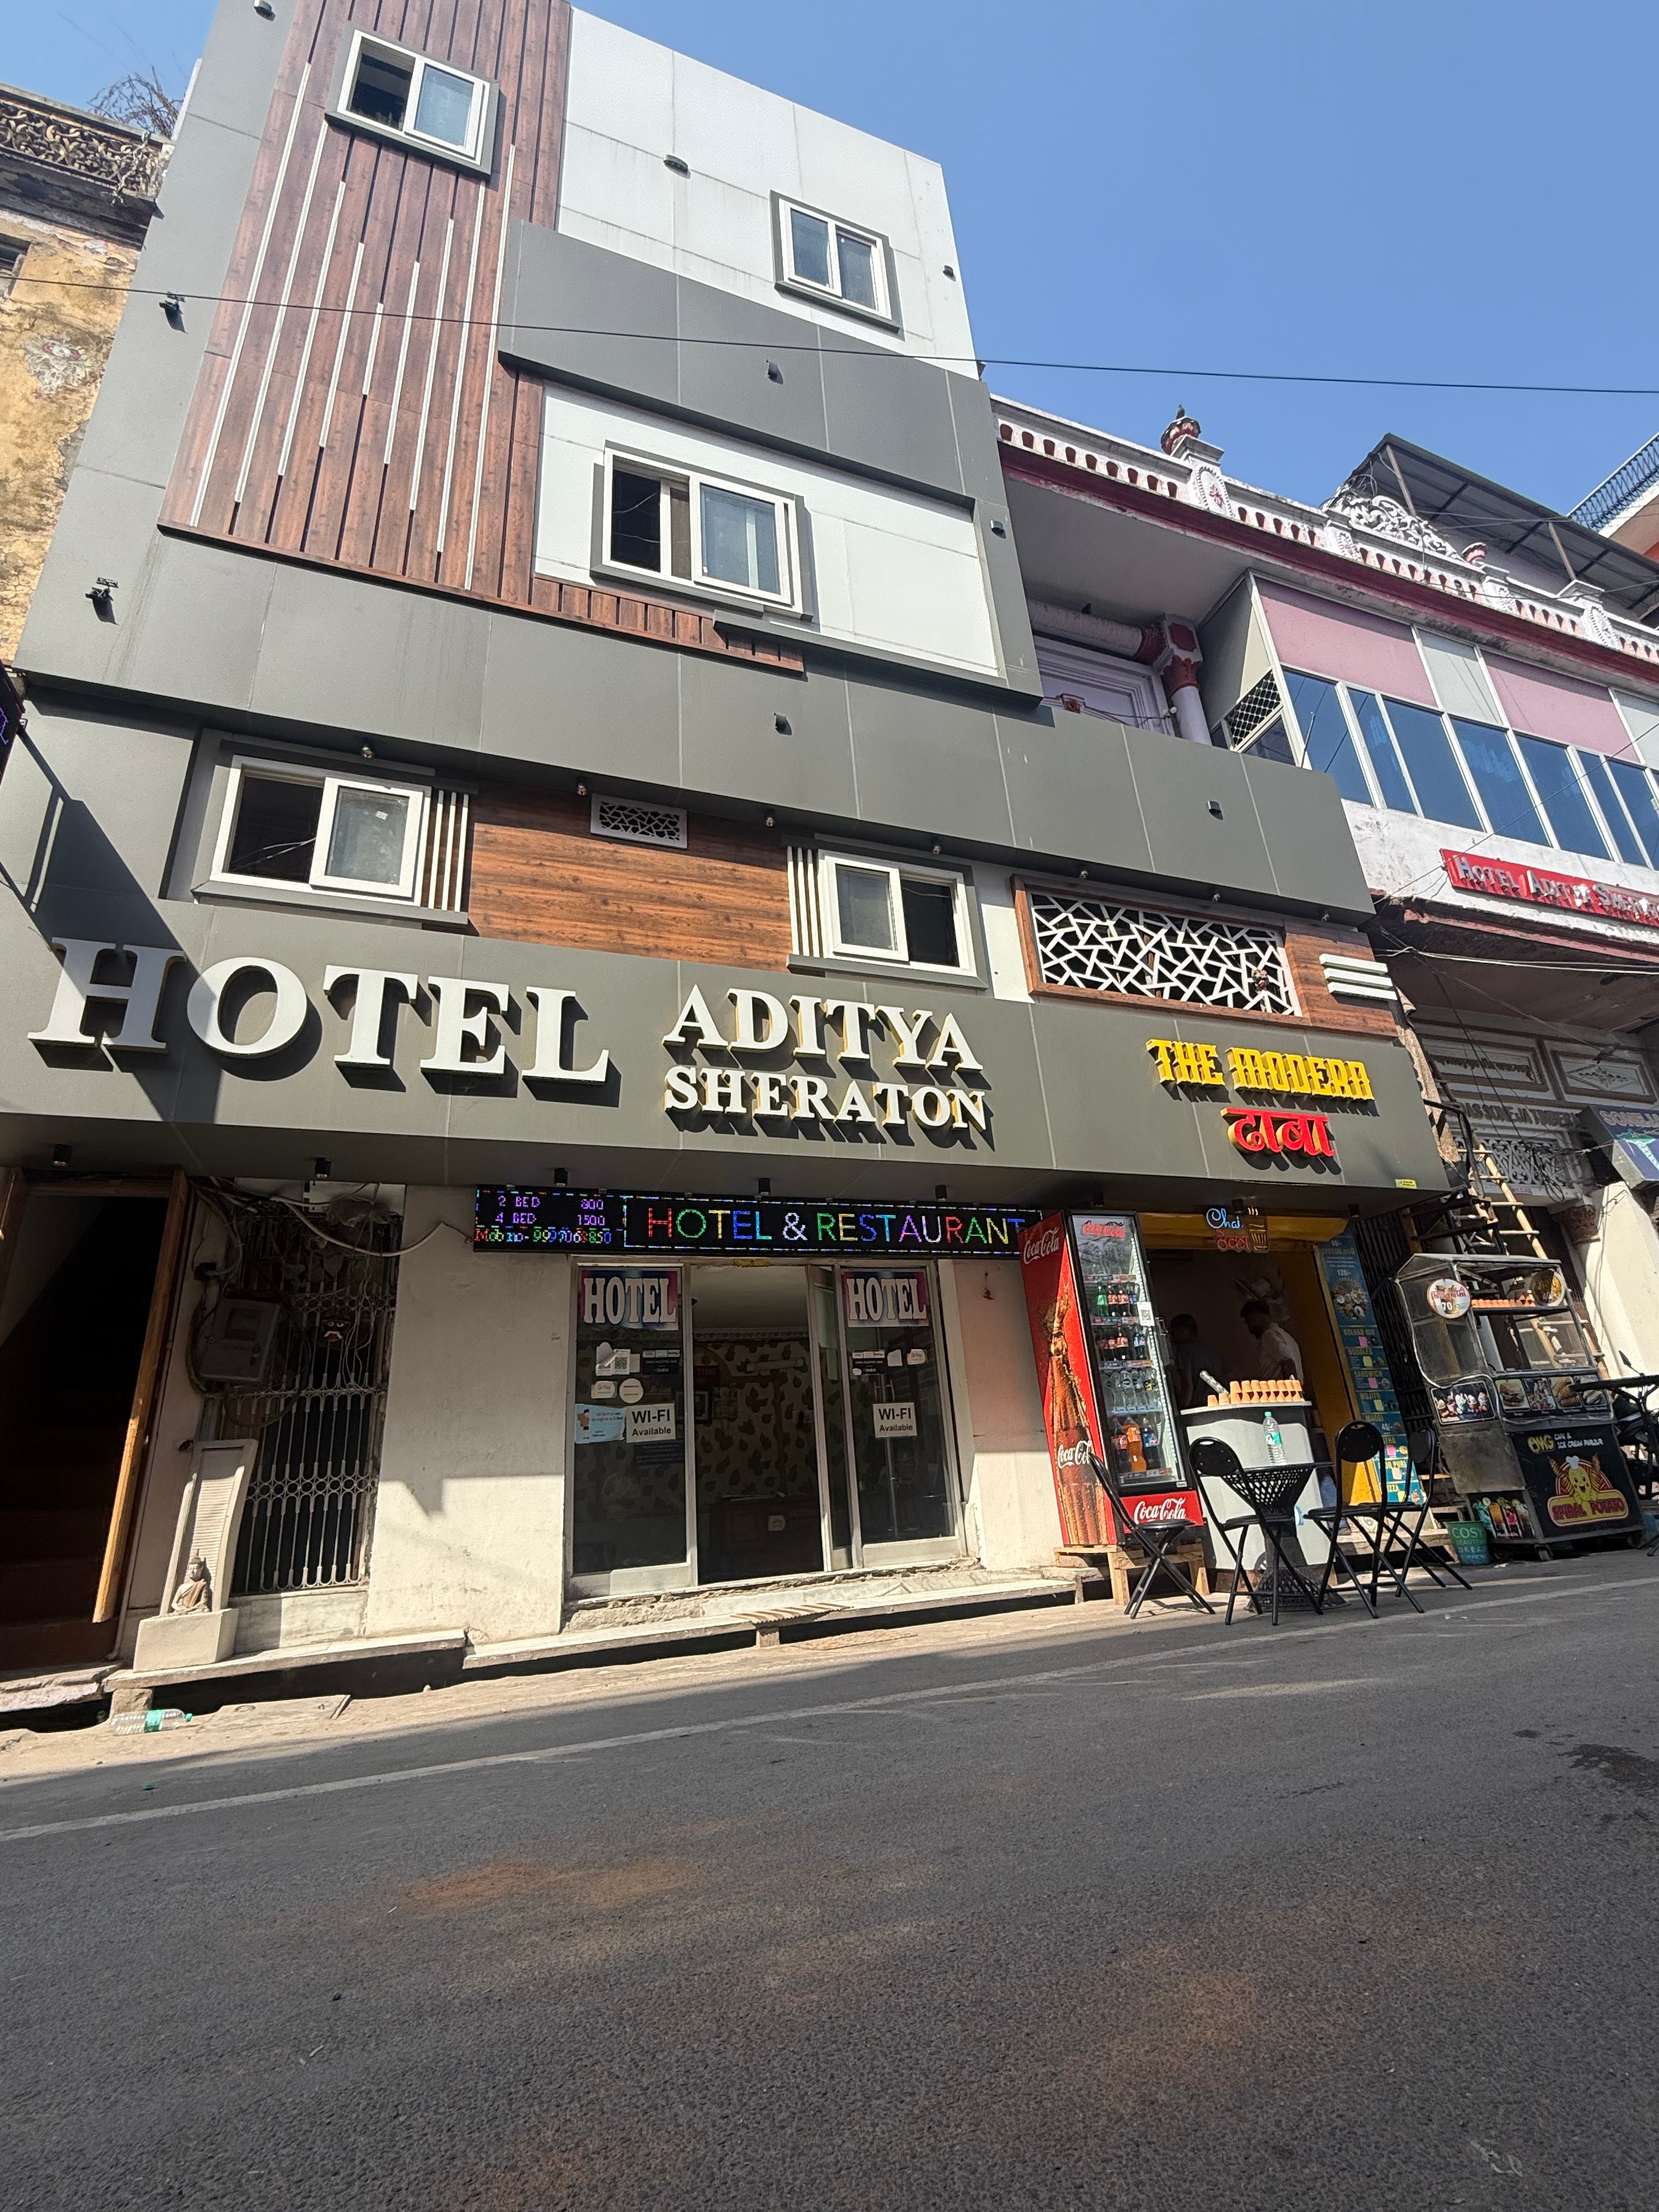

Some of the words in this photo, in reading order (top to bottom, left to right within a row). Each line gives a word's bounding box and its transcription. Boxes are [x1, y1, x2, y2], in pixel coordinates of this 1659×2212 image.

[1452, 854, 1520, 891] HOTEL
[27, 936, 610, 1084] HOTEL
[662, 984, 984, 1071] ADITYA
[1146, 1039, 1224, 1086] THE
[1225, 1047, 1375, 1101] MODERN
[663, 1065, 986, 1132] SHERATON
[1221, 1107, 1335, 1157] ढाबा
[498, 1195, 506, 1207] 2
[515, 1196, 541, 1208] BED
[495, 1211, 504, 1223] 4
[512, 1212, 537, 1224] BED
[577, 1214, 606, 1226] 1500
[648, 1207, 772, 1240] HOTEL
[782, 1212, 808, 1241] &
[816, 1212, 1025, 1244] RESTAURANT
[1206, 1208, 1240, 1228] Chai
[1023, 1226, 1059, 1265] Coca-Cola
[583, 1276, 677, 1325] HOTEL
[846, 1277, 927, 1322] HOTEL
[631, 1408, 670, 1424] WI-FI
[878, 1407, 912, 1420] WI-FI
[879, 1423, 913, 1432] Available
[631, 1426, 672, 1437] Available
[1527, 1434, 1555, 1454] OMG
[1058, 1440, 1092, 1469] Coca-Col
[1386, 1483, 1400, 1492] IZZA
[1133, 1497, 1187, 1525] Coca-Cola
[1551, 1502, 1588, 1521] SPIRAL
[1589, 1498, 1626, 1515] POTATO
